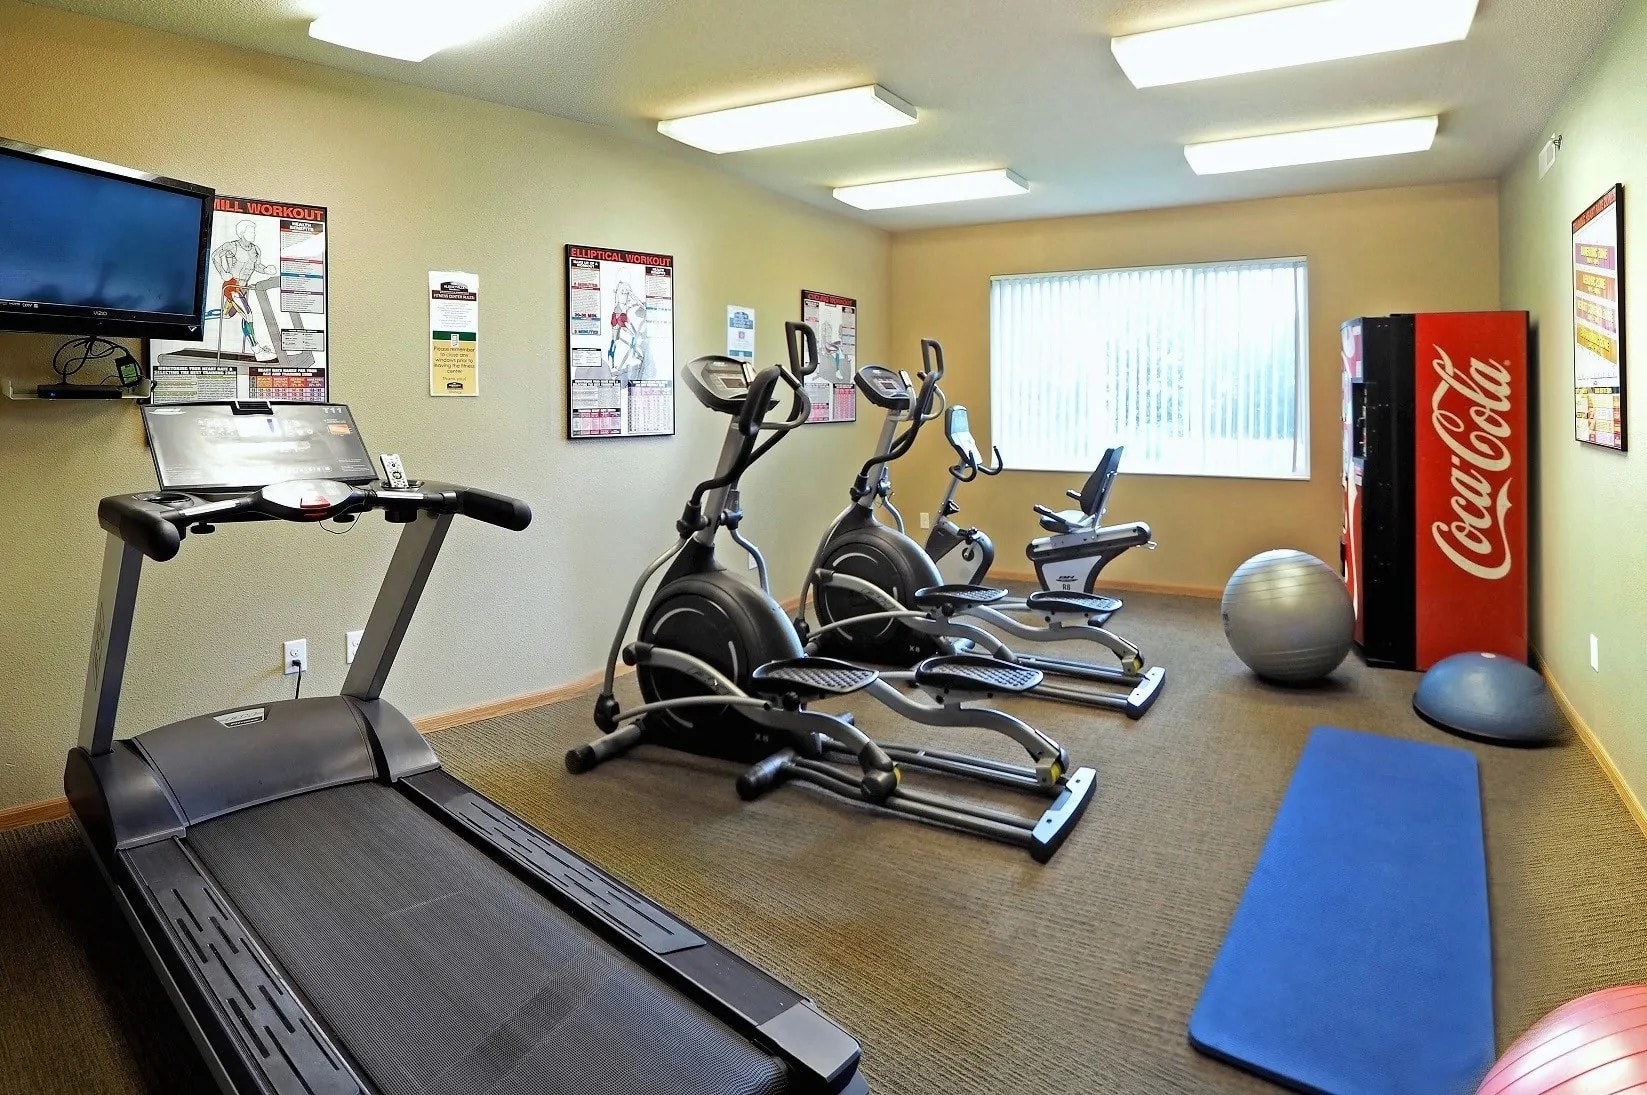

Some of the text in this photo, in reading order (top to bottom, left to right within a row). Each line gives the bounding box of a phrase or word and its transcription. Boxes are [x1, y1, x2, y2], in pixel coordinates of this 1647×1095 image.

[246, 202, 323, 221] WORKOUT
[571, 248, 671, 266] ELLIPTICAL WORKOUT
[1432, 343, 1512, 580] Coca-Cola
